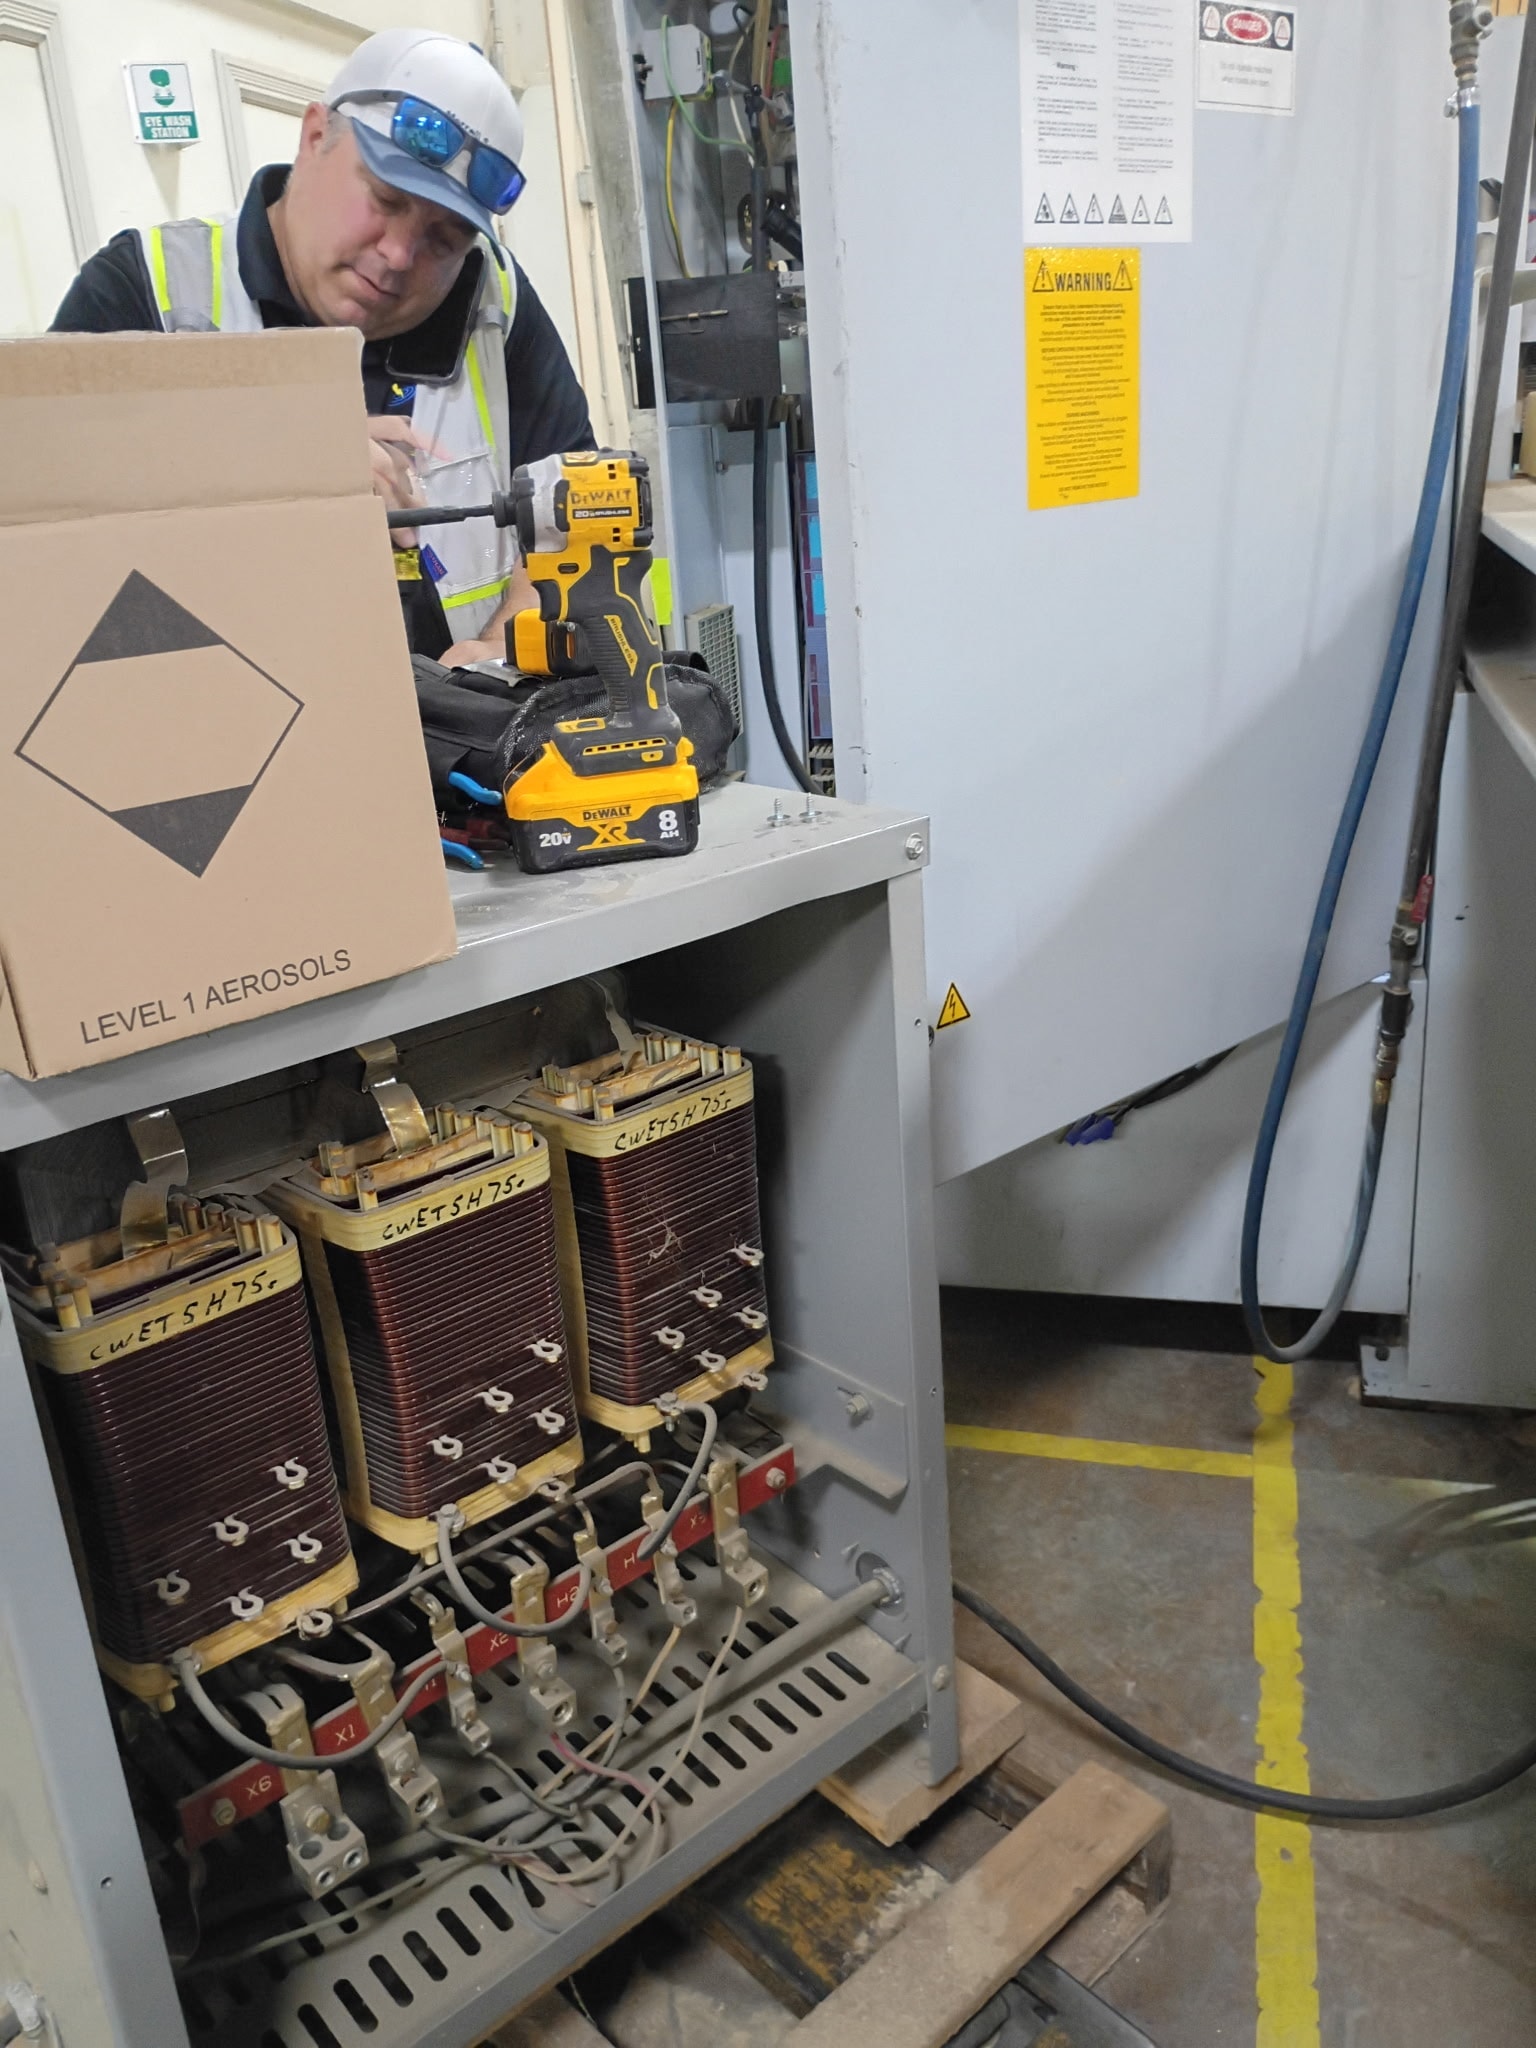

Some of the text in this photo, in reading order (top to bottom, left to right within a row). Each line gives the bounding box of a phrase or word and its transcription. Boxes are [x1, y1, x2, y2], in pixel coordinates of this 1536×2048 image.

[144, 115, 193, 127] EYE WASH
[151, 127, 190, 138] STATION
[1054, 272, 1112, 292] WARNING
[610, 618, 634, 664] BRUSHLESS
[658, 810, 678, 831] 8
[580, 821, 640, 849] XR
[80, 949, 351, 1045] LEVEL 1 AEROSOLS
[490, 1631, 509, 1651] X2
[334, 1723, 357, 1746] X1
[245, 1775, 273, 1799] X6
